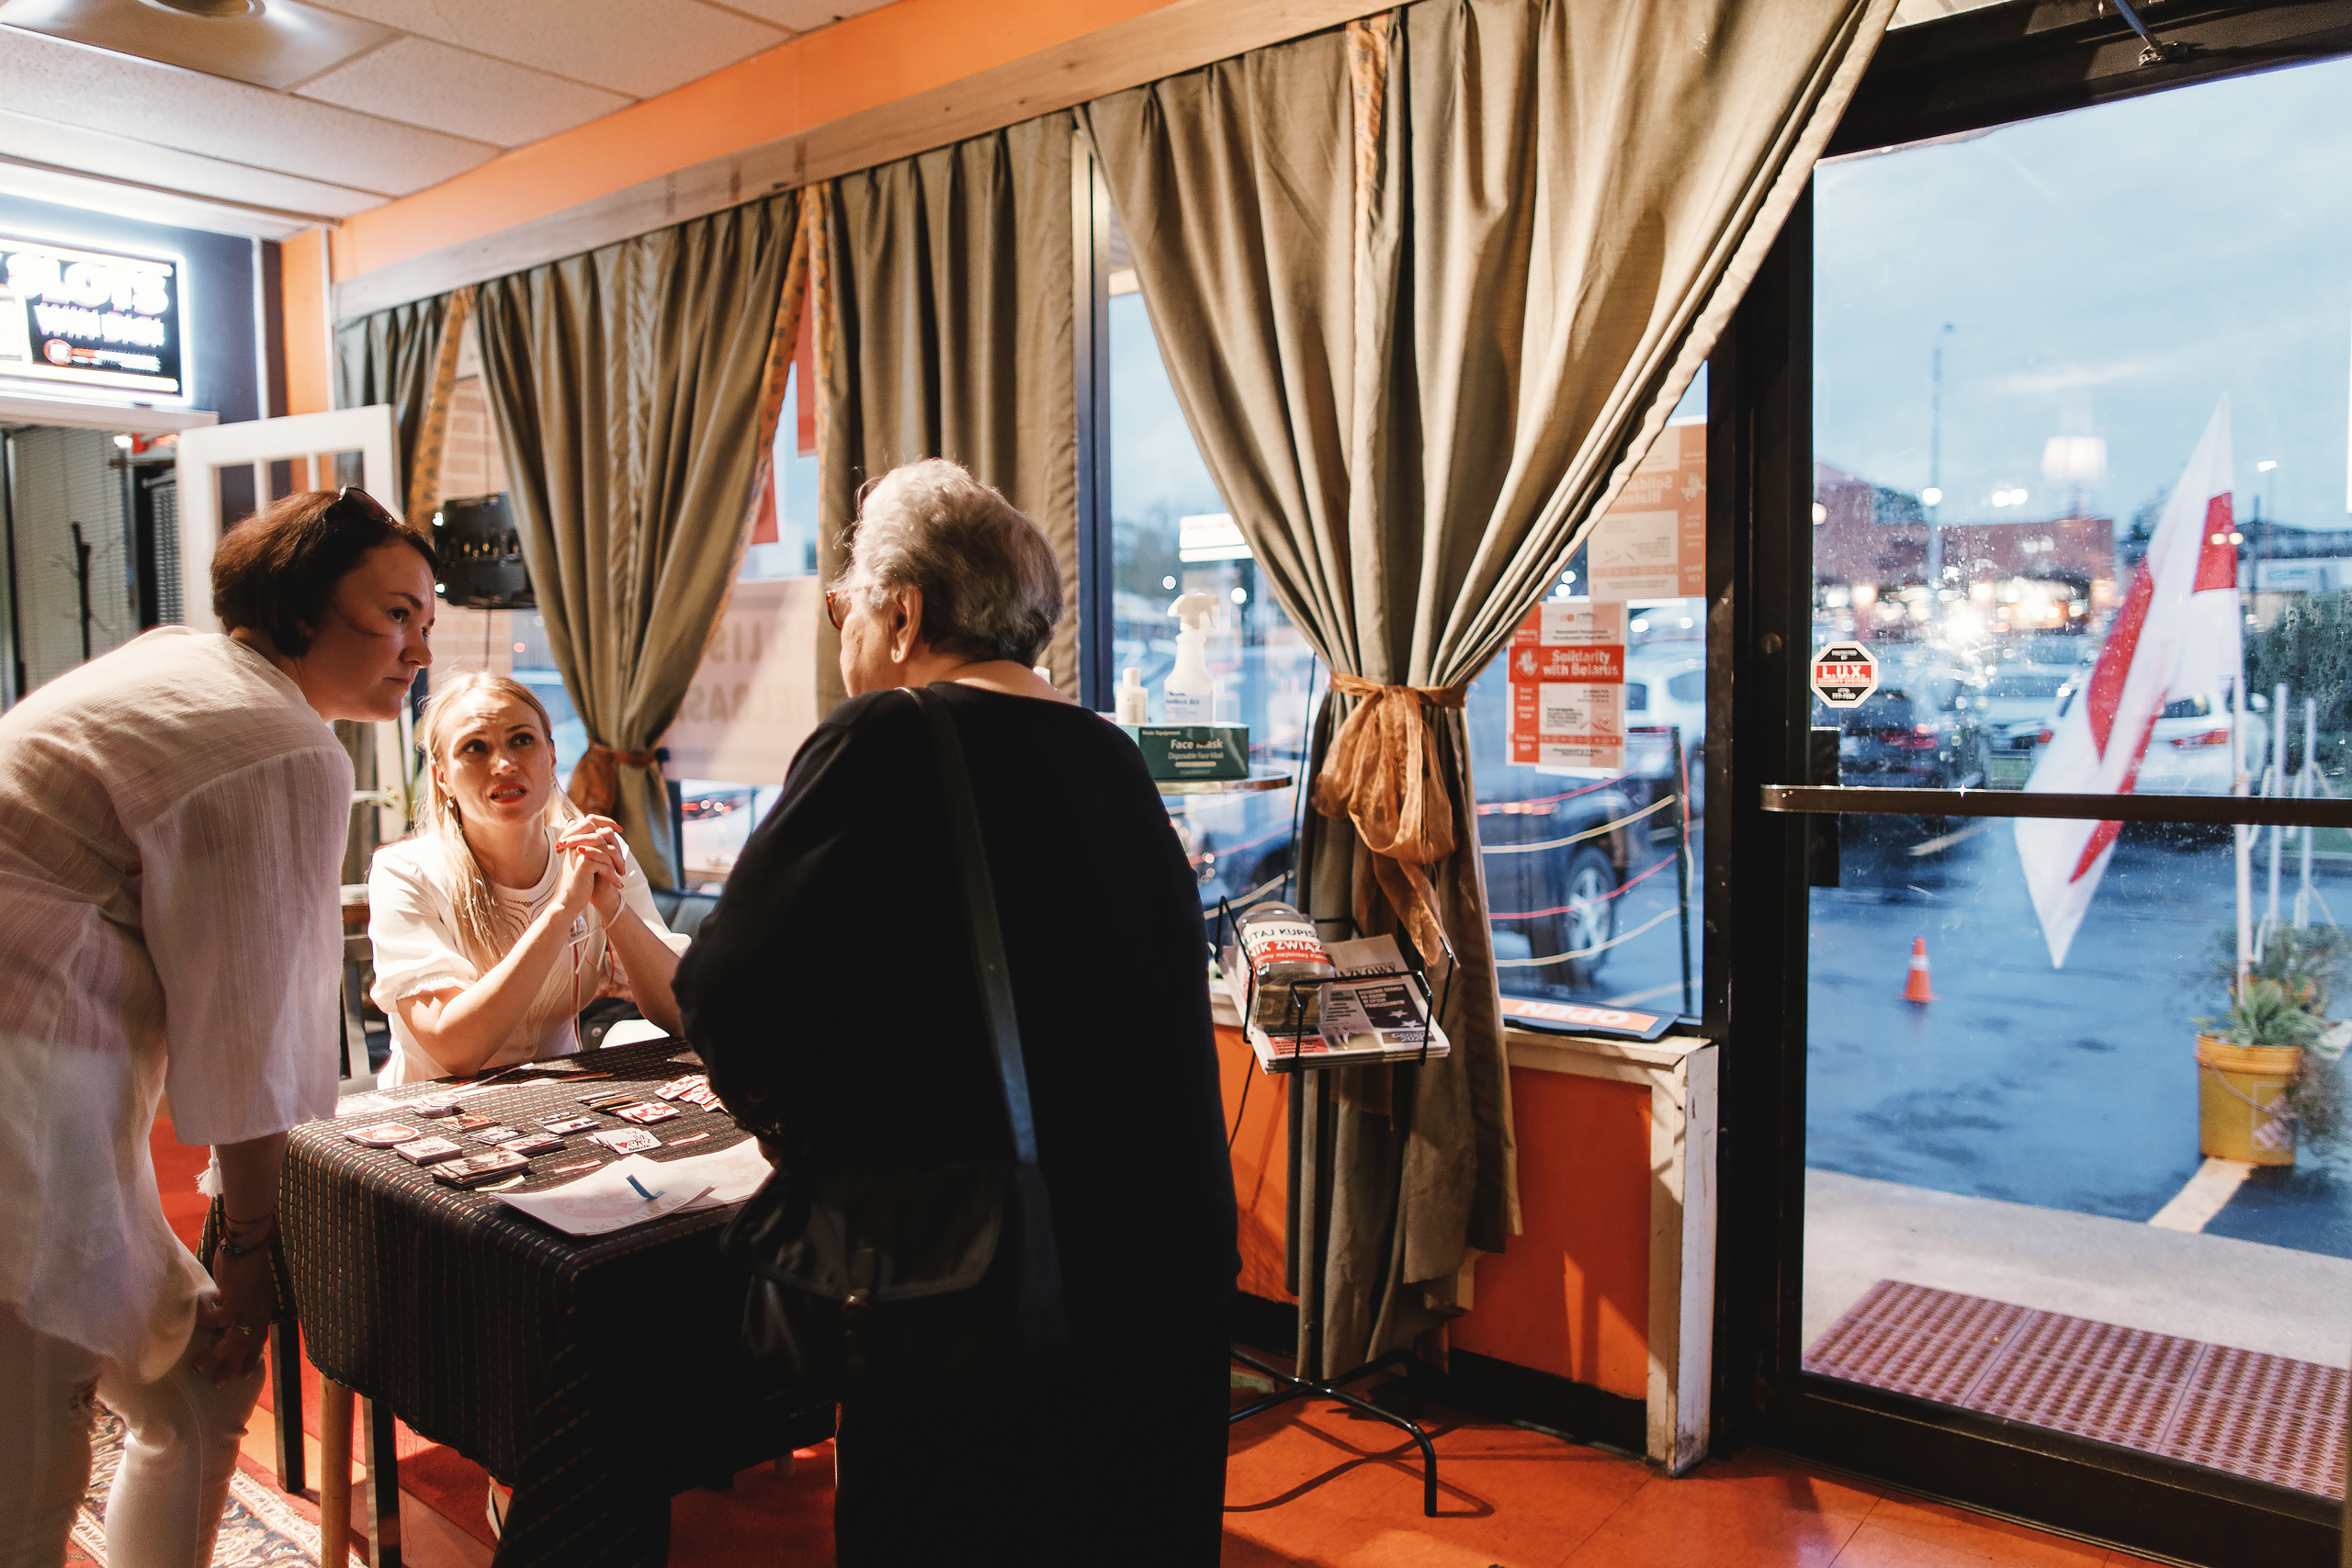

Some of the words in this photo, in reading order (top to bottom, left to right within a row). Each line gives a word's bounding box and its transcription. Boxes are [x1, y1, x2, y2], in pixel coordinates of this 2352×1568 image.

[1552, 649, 1611, 665] Solidarity
[1542, 662, 1569, 676] with
[1570, 661, 1619, 676] Belarus
[1170, 739, 1193, 749] Face
[1515, 1000, 1630, 1025] OPEN
